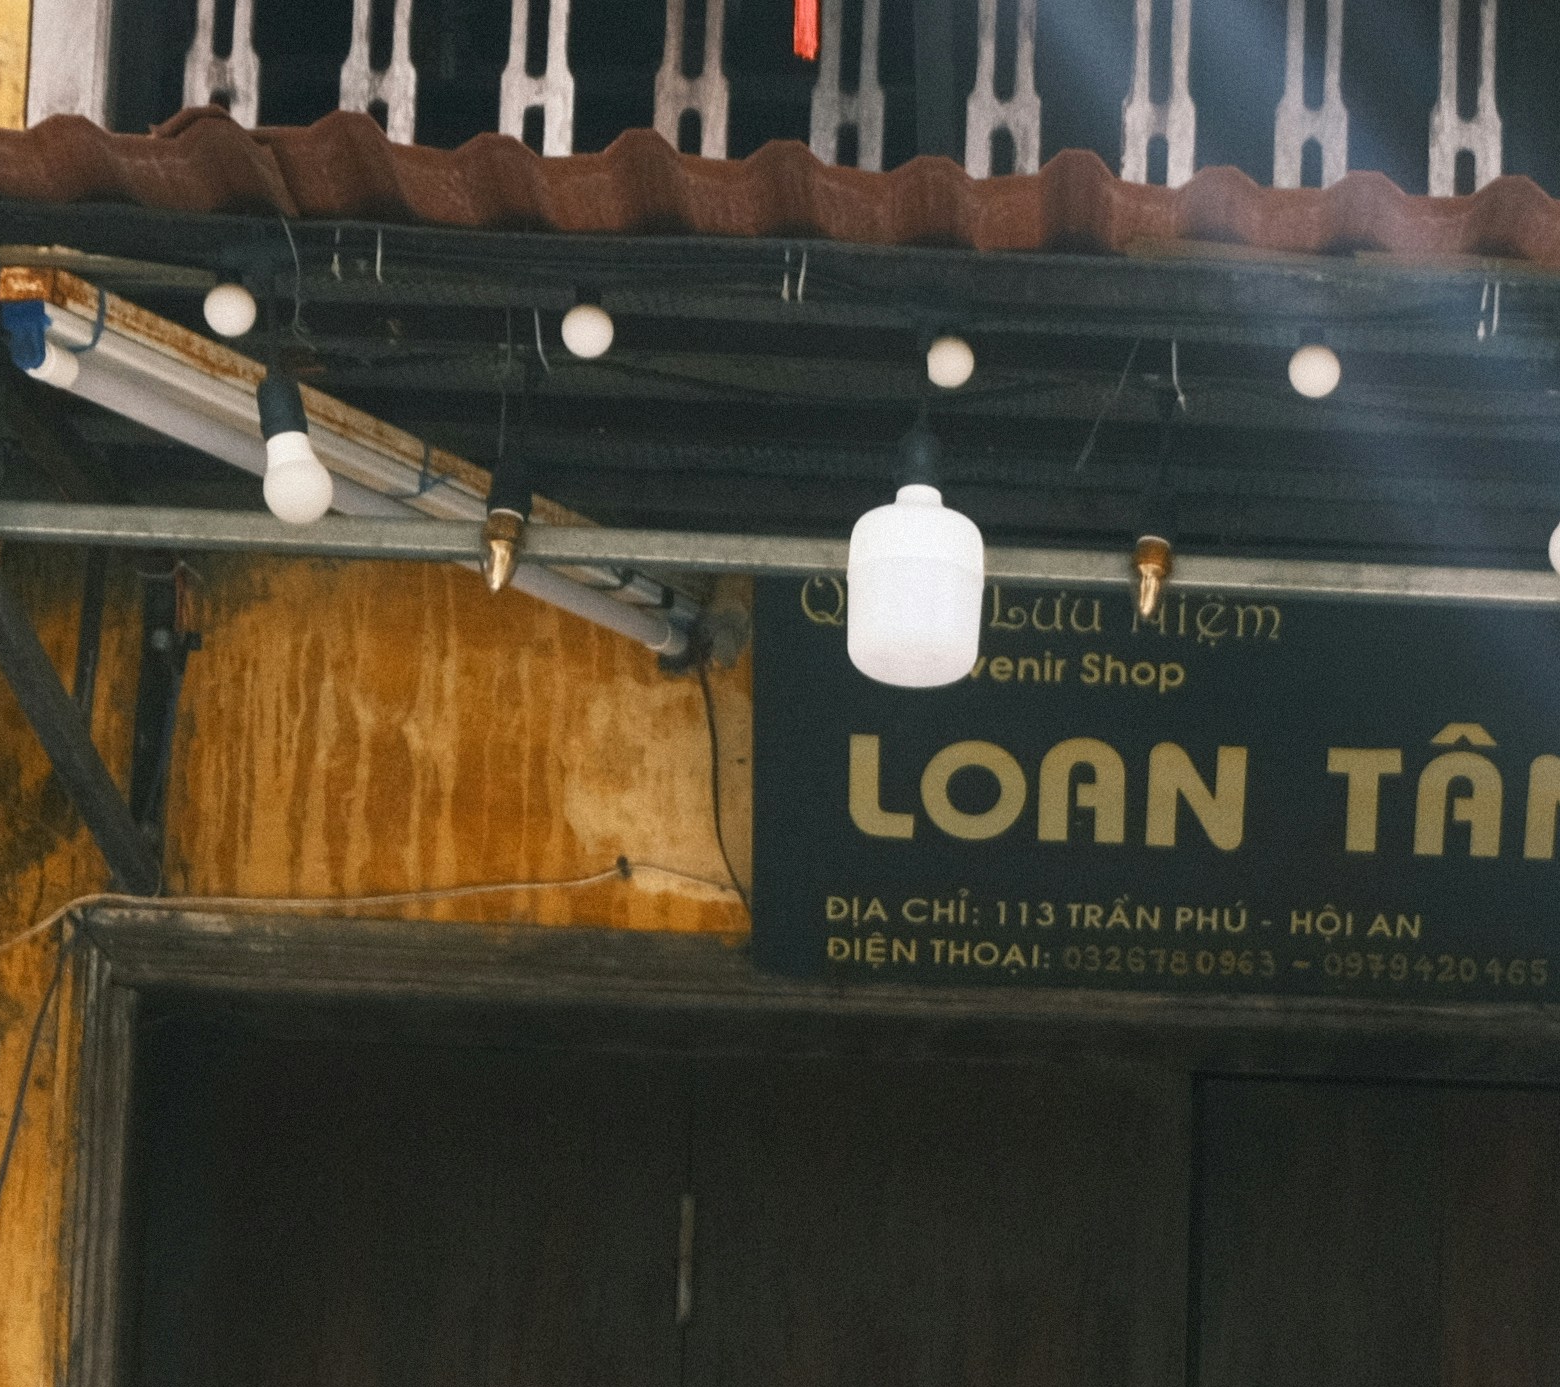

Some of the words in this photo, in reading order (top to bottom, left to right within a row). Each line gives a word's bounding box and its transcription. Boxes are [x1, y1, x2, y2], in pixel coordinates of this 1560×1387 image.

[968, 651, 1067, 683] venir
[1080, 653, 1185, 694] Shop
[848, 733, 1248, 850] LOAN
[825, 896, 888, 927] ĐỊA
[901, 888, 980, 925] CHỈ:
[996, 901, 1055, 927] 113
[1066, 894, 1161, 931] TRẦN
[1175, 901, 1247, 932] PHÚ
[1290, 903, 1353, 943] HỘI
[1366, 912, 1421, 939] AN
[827, 932, 917, 969] ĐIỆN
[930, 940, 1050, 975] THOẠI:
[1064, 945, 1276, 977] 0326780963
[1323, 953, 1548, 987] 0979420465
